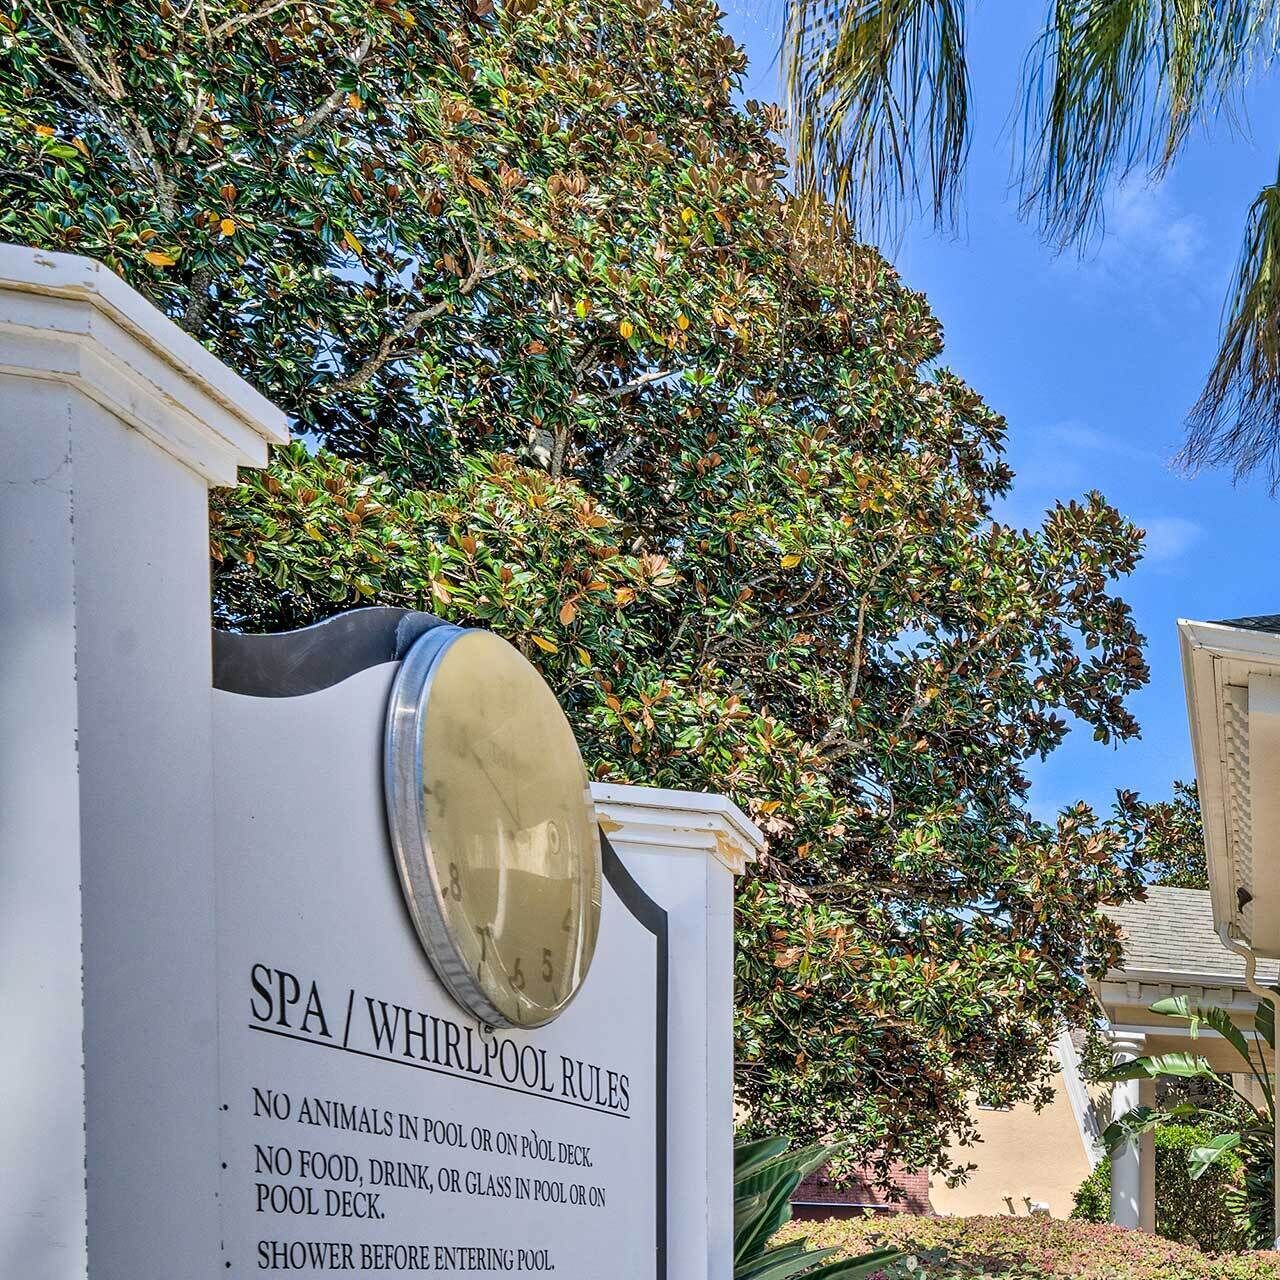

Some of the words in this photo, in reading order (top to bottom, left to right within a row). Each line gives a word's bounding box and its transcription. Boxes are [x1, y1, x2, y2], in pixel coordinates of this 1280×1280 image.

[542, 948, 554, 982] 5
[249, 962, 333, 1039] SPA
[342, 989, 357, 1051] /
[365, 996, 556, 1095] WHIRLPOOL
[559, 1054, 630, 1113] RULES
[251, 1086, 291, 1121] NO
[296, 1096, 394, 1138] ANIMALS
[397, 1113, 419, 1141] IN
[422, 1117, 468, 1149] POOL
[470, 1126, 494, 1153] OR
[495, 1131, 518, 1156] ON
[520, 1128, 557, 1163] POOL
[557, 1141, 594, 1168] DECK.
[253, 1143, 293, 1177] NO
[297, 1149, 364, 1189] FOOD,
[368, 1158, 434, 1195] DRINK,
[437, 1167, 463, 1194] OR
[464, 1170, 512, 1199] GLASS
[514, 1176, 531, 1200] IN
[533, 1179, 568, 1204] POOL
[568, 1183, 588, 1206] OR
[588, 1185, 606, 1208] ON
[254, 1182, 320, 1216] POOL
[323, 1188, 386, 1220] DECK.
[257, 1239, 356, 1270] SHOWER
[359, 1243, 431, 1271] BEFORE
[433, 1245, 515, 1272] ENTERING
[516, 1248, 556, 1272] POOL.
